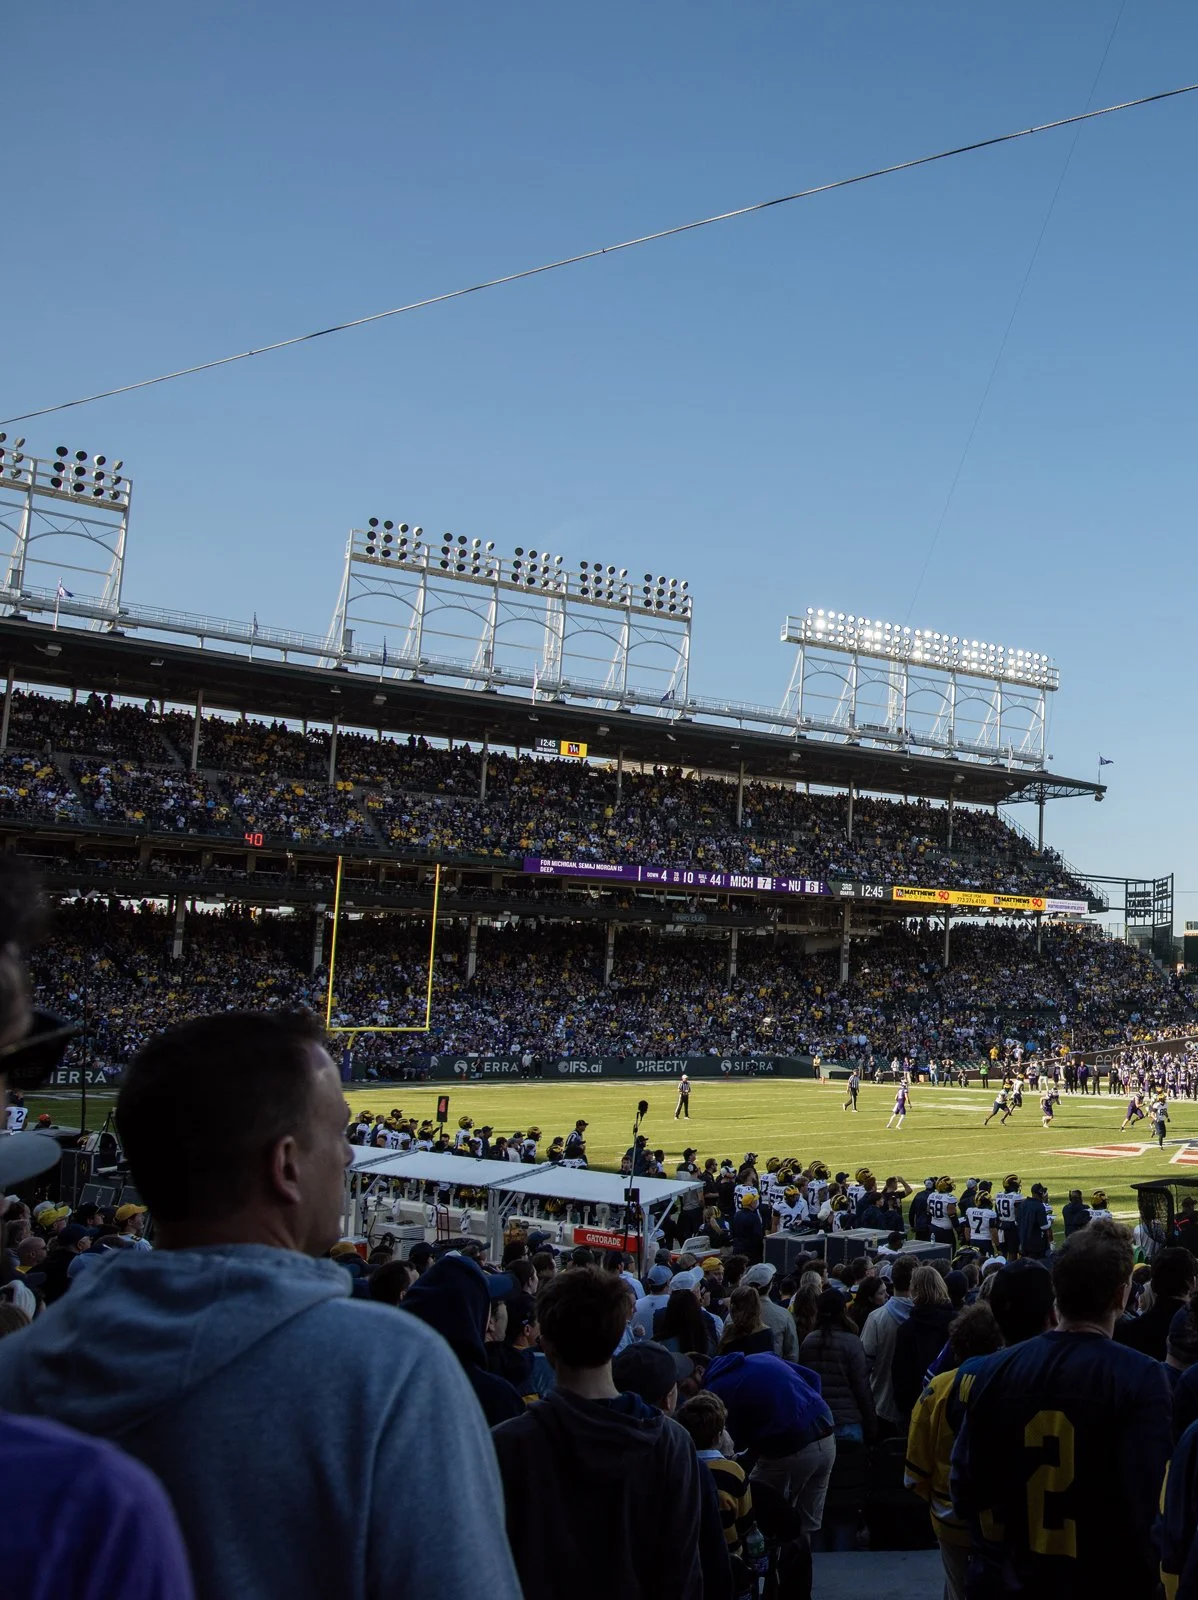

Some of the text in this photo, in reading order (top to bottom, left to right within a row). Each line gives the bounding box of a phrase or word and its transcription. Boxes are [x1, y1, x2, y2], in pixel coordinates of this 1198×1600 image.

[540, 739, 556, 748] 12:45
[245, 833, 263, 846] 40
[661, 870, 668, 882] 4
[683, 871, 694, 884] 10
[709, 874, 721, 885] 44
[730, 876, 754, 889] MICH
[788, 880, 801, 892] NU
[809, 881, 815, 892] 6
[841, 883, 852, 891] 3RD
[861, 884, 884, 898] 12:45
[904, 888, 950, 901] MATTHEWS 90
[1001, 896, 1030, 904] MATTHEWS
[1032, 897, 1043, 908] 90
[470, 1061, 519, 1072] SERRA
[569, 1059, 603, 1073] IFS.ai
[636, 1060, 688, 1072] DIRECTV
[15, 1110, 24, 1123] 2
[997, 1199, 1011, 1218] 19
[972, 1216, 983, 1234] 7
[586, 1233, 621, 1246] GATORADE
[1024, 1410, 1078, 1559] 2
